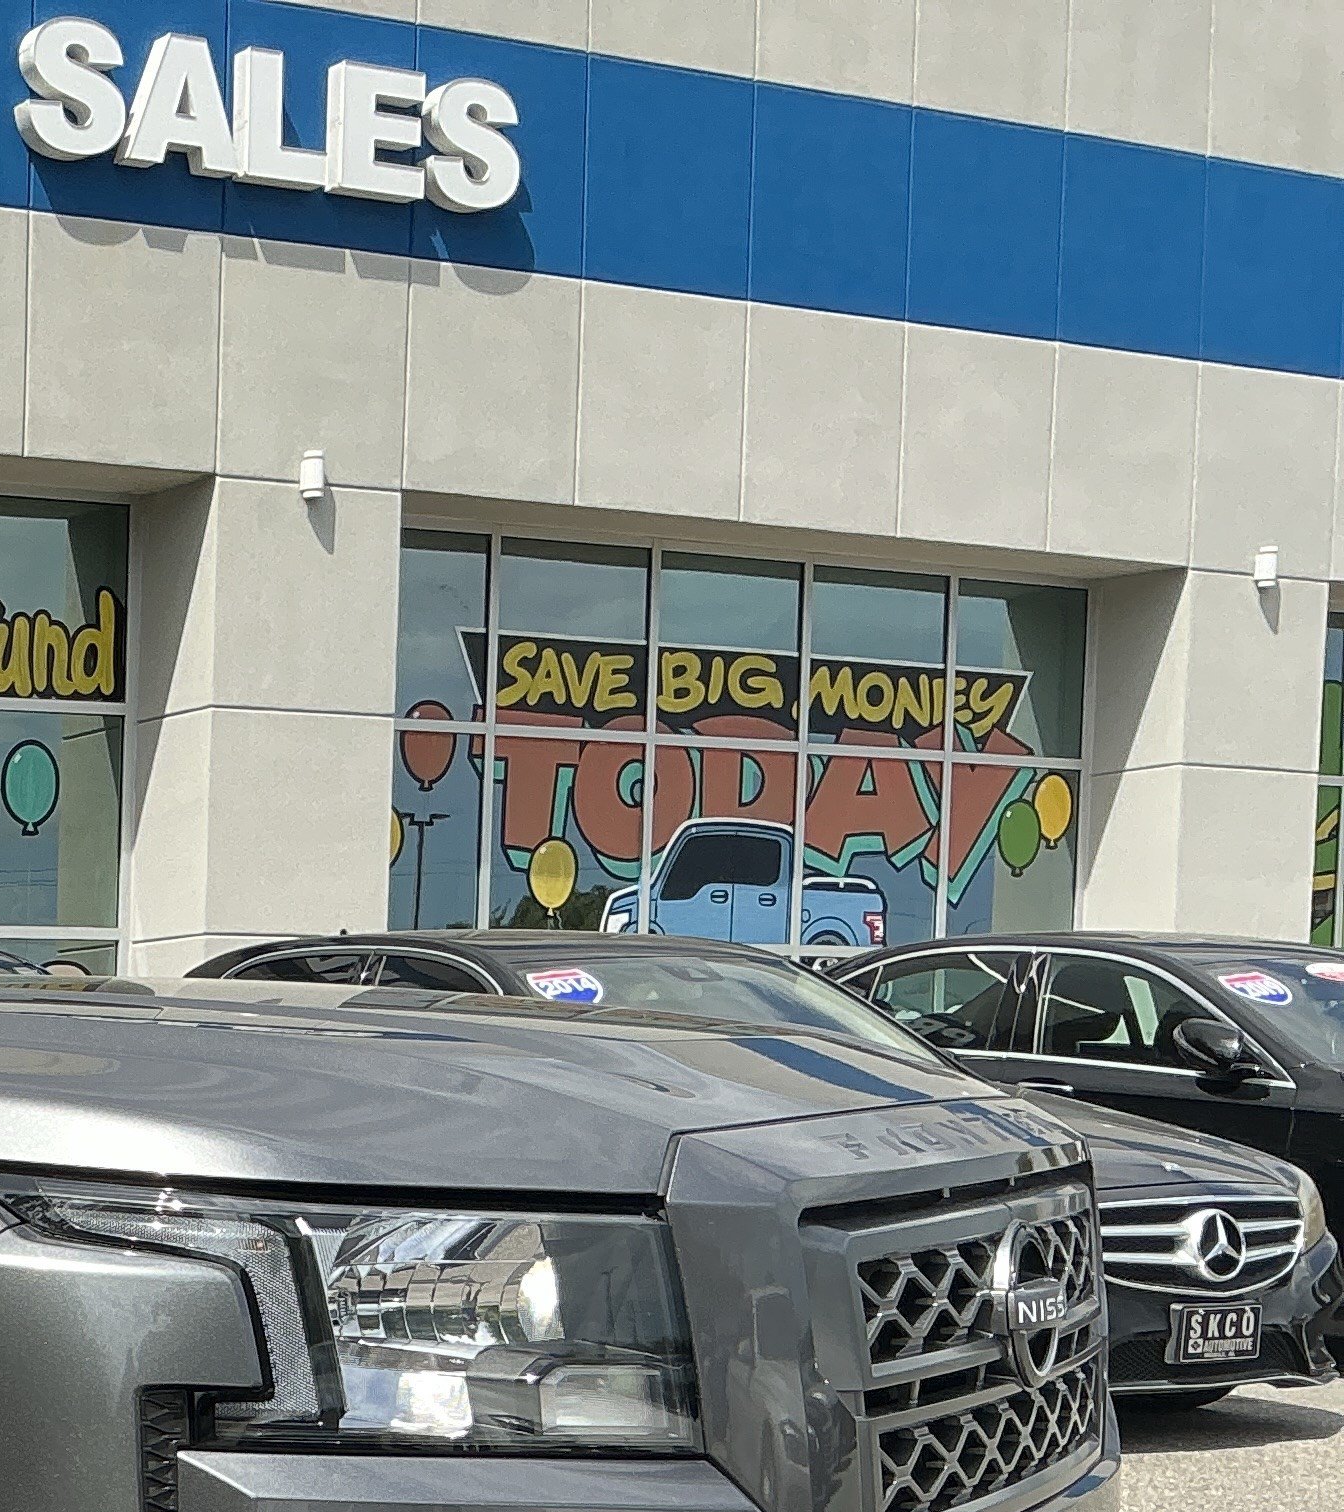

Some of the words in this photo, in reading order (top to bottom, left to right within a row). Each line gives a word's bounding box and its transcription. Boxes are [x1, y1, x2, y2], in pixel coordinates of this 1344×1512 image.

[15, 16, 521, 213] SALES
[495, 641, 637, 710] SAVE
[656, 651, 785, 712] BIG
[792, 664, 1014, 737] MONEY
[473, 706, 1036, 902] TODAY
[538, 977, 598, 996] 2014
[1017, 1295, 1065, 1324] NISS
[1189, 1312, 1255, 1339] SKCO
